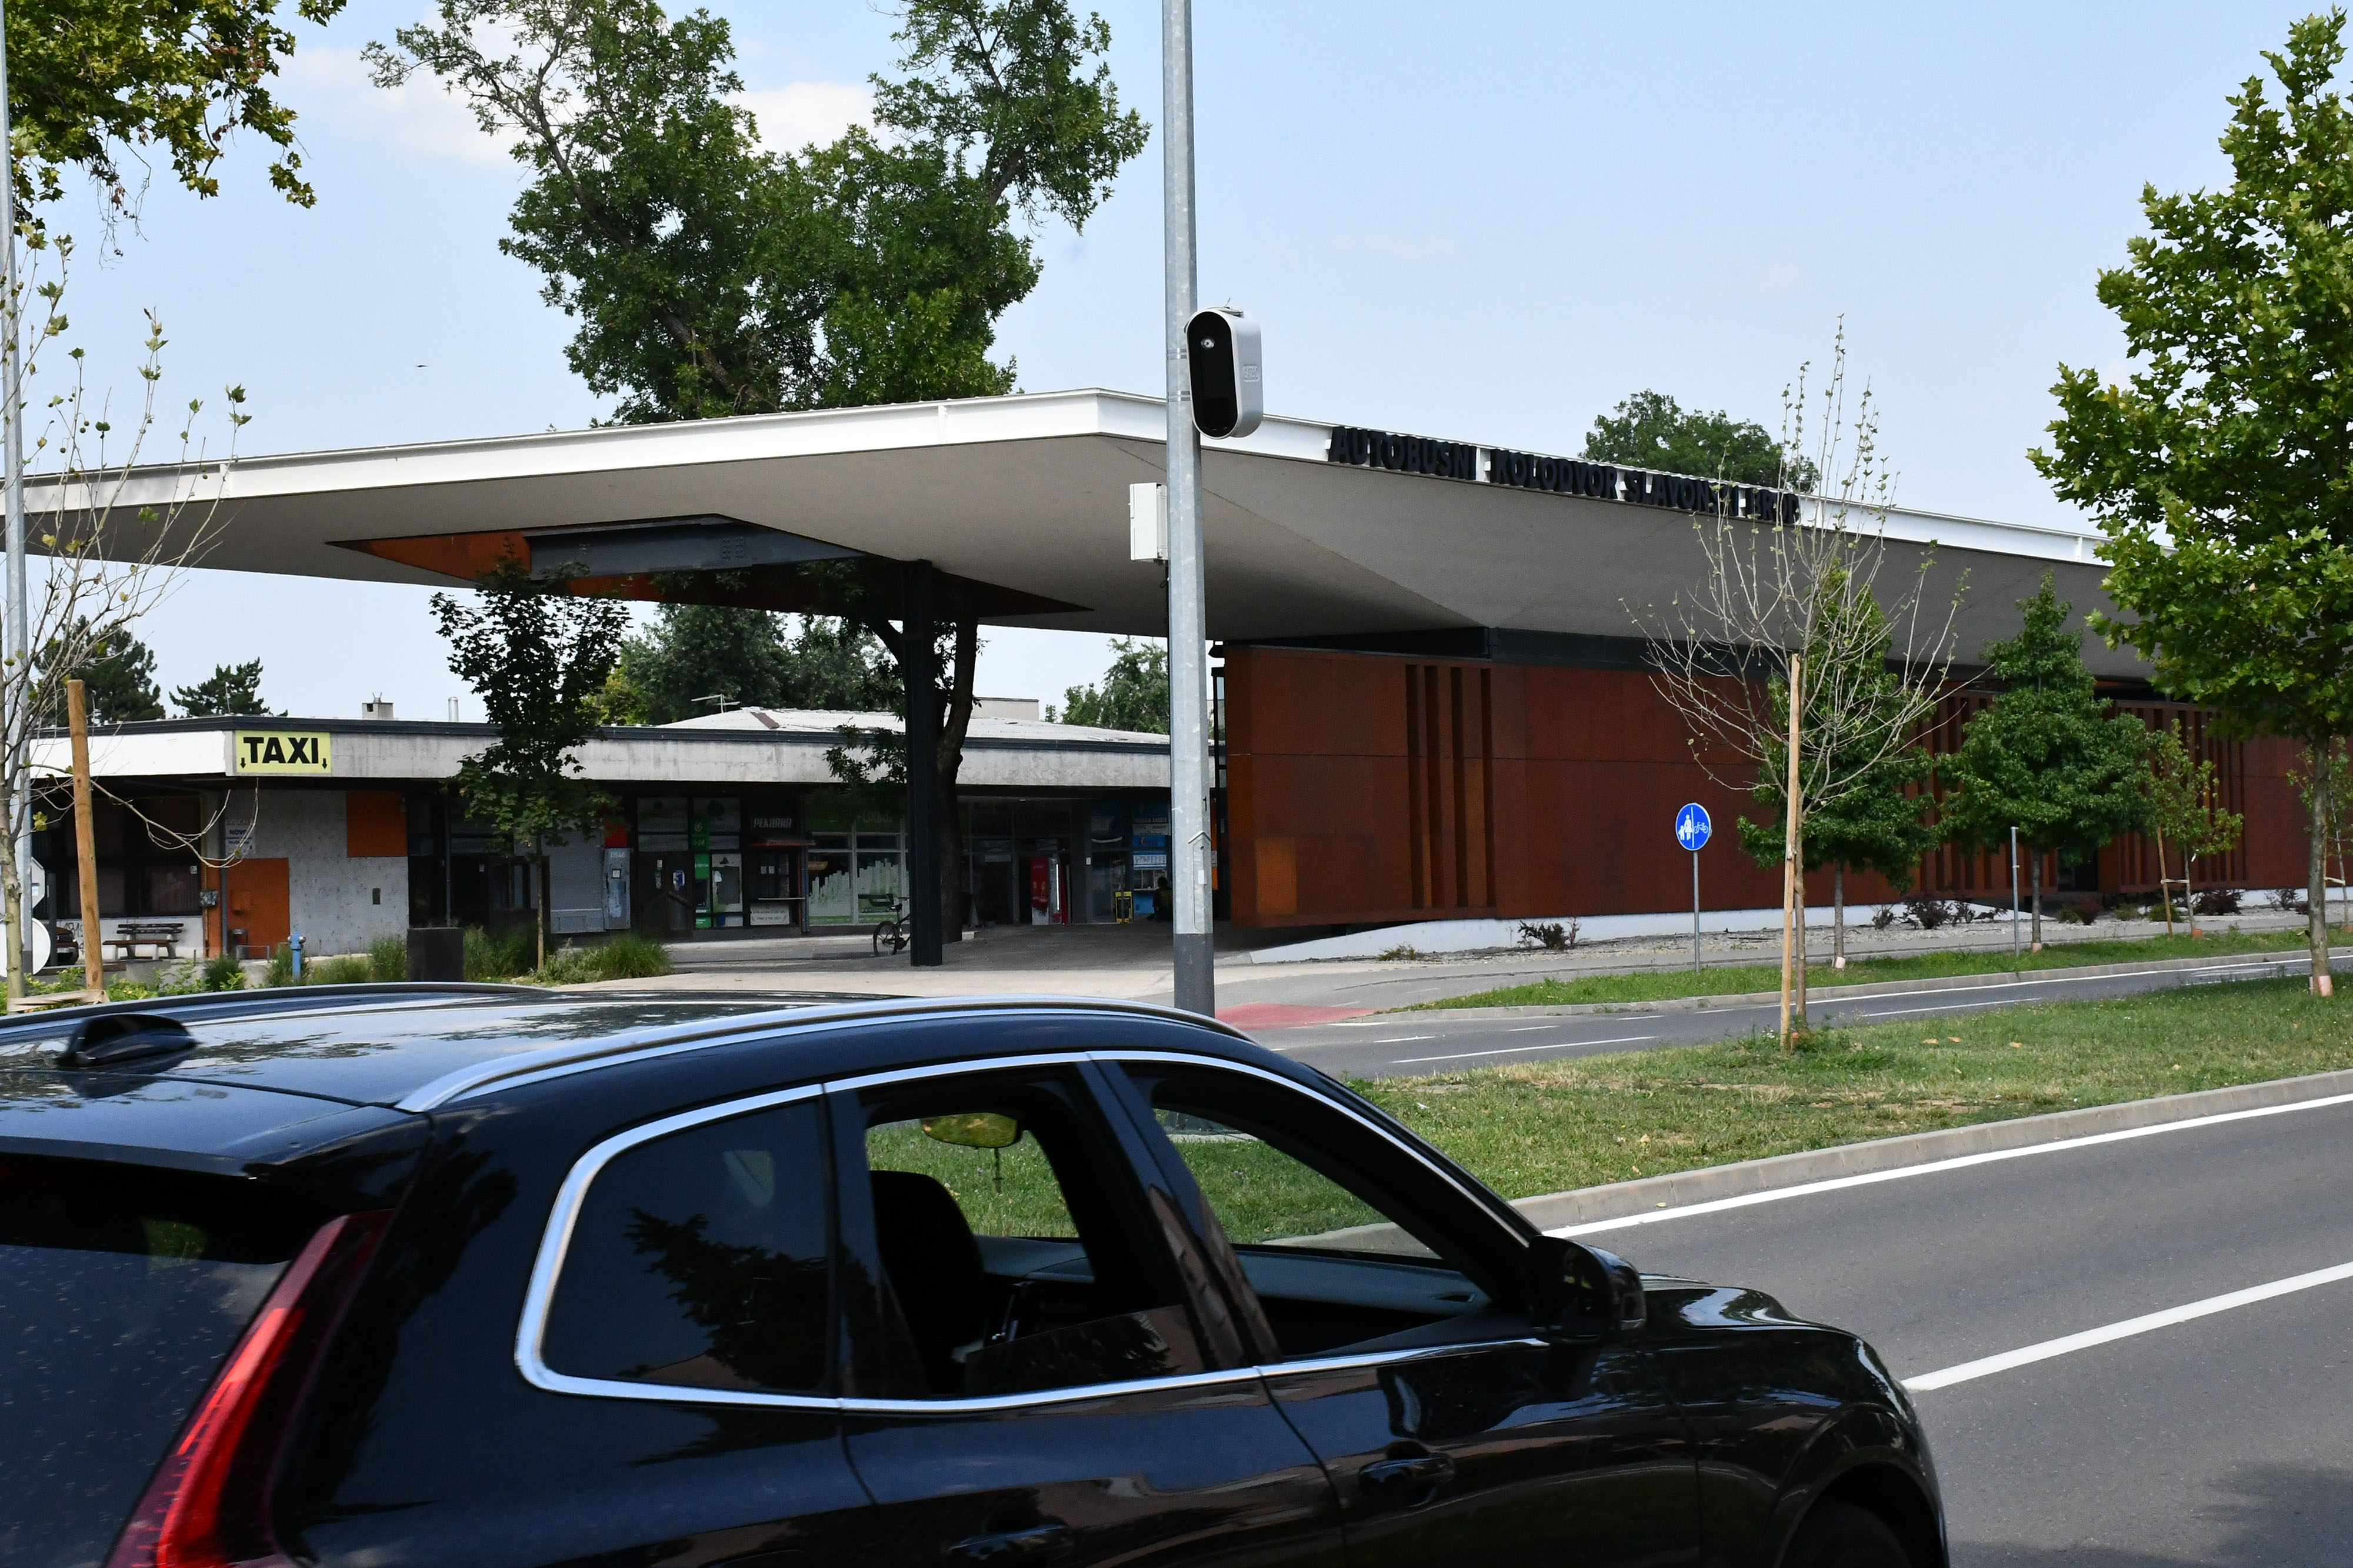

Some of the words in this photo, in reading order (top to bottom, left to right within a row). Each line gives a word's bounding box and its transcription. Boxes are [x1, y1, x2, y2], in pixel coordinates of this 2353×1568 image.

[1329, 426, 1476, 481] AUTOBUSNI
[1491, 449, 1618, 499] KOLODVOR
[1624, 470, 1739, 517] SLAVONSKI
[243, 737, 319, 763] TAXI
